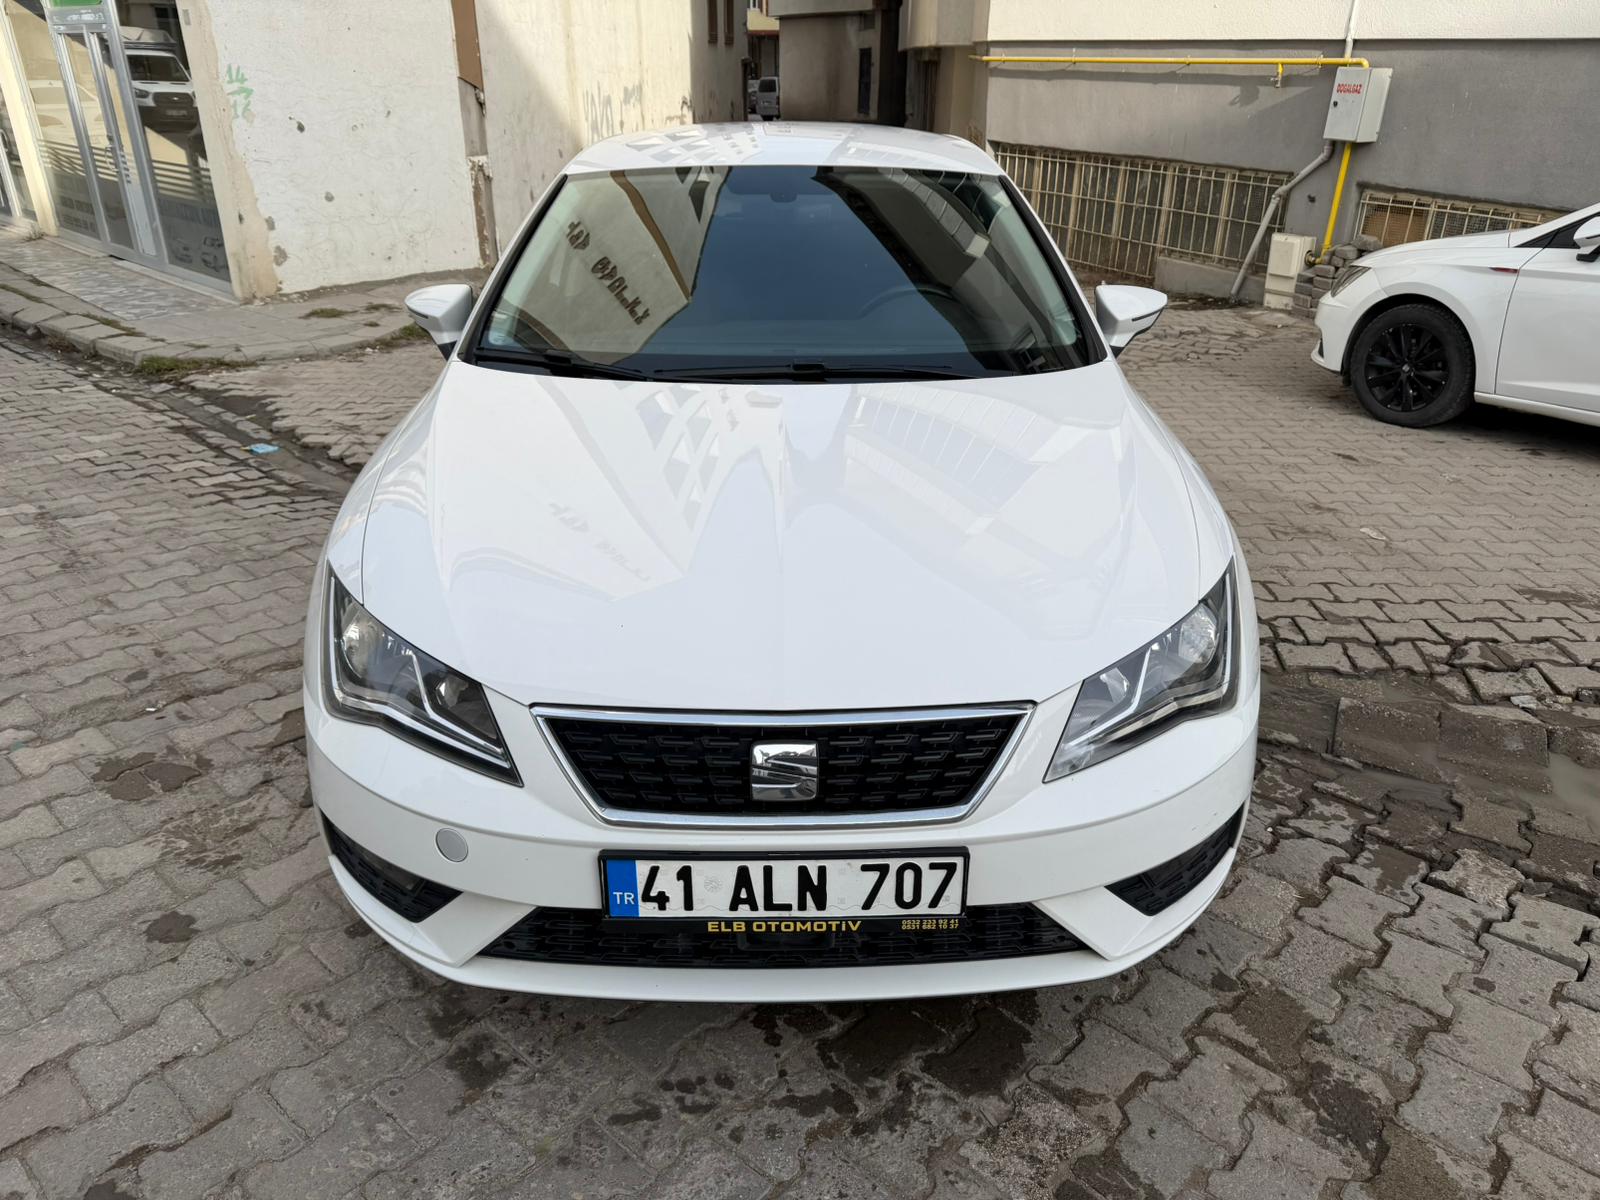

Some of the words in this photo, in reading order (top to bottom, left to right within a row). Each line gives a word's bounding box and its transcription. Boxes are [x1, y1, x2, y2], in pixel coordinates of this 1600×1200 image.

[641, 865, 694, 912] 41
[729, 865, 828, 912] ALN
[861, 861, 958, 911] 707
[613, 891, 635, 905] TR
[707, 921, 746, 932] ELB
